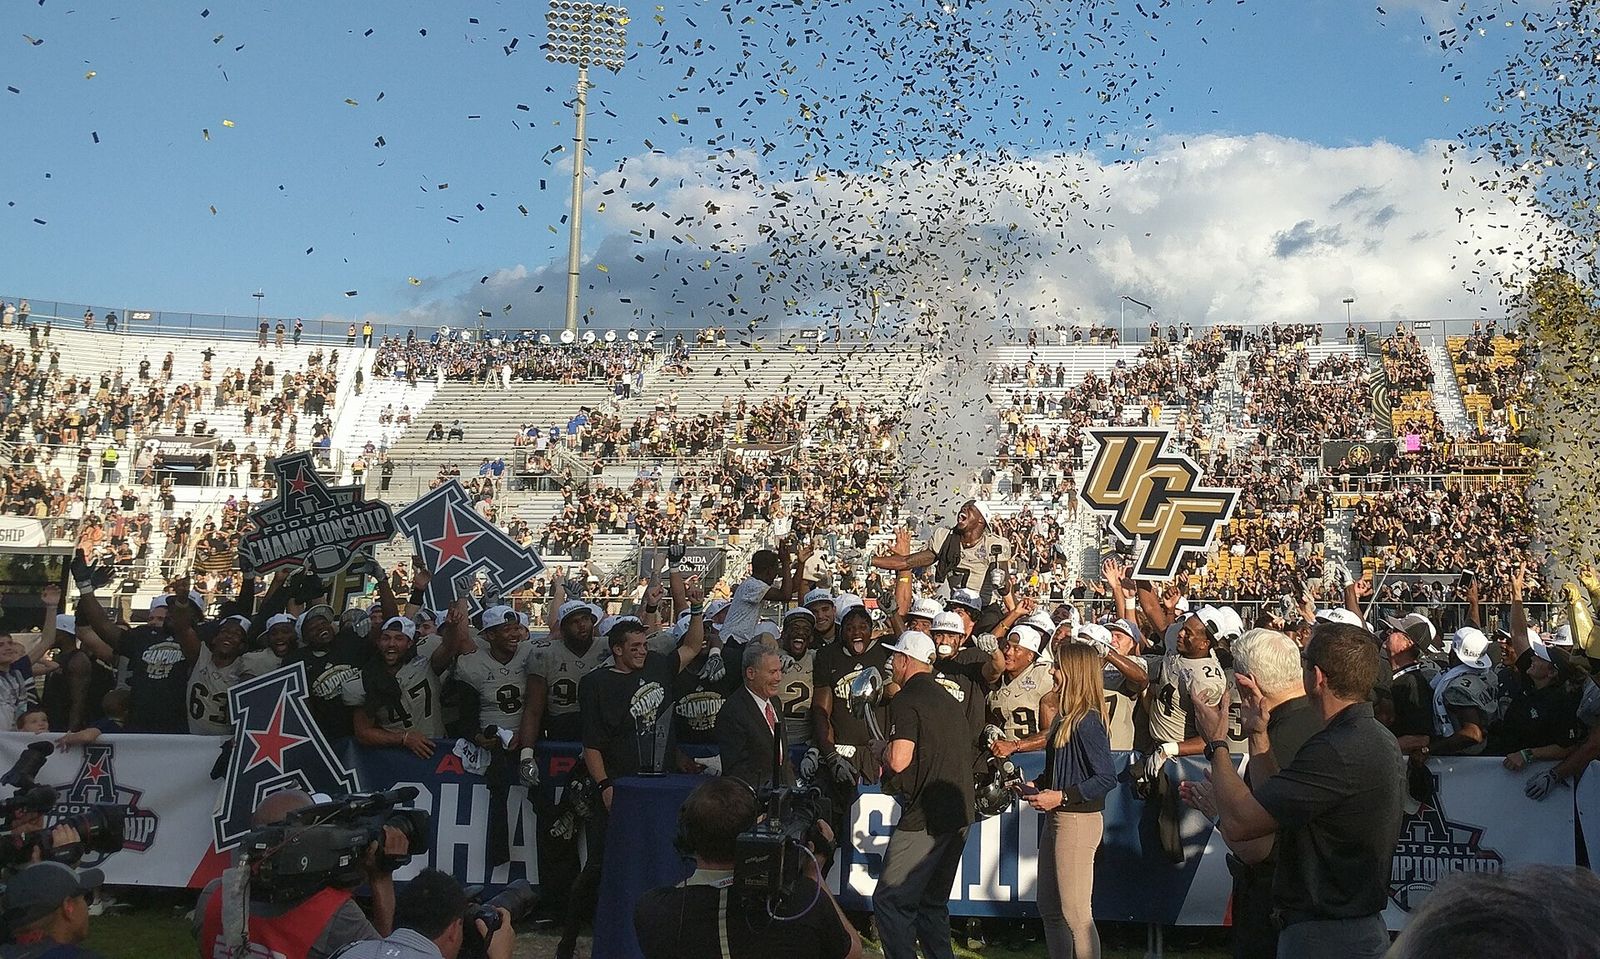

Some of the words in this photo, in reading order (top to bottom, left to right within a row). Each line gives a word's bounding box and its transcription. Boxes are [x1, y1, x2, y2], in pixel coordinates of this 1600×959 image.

[1080, 429, 1236, 577] UCF
[263, 504, 363, 535] FOOTBALL
[247, 507, 388, 568] CHAMPIONSHIP
[1201, 664, 1224, 681] 24
[386, 677, 432, 730] 47
[496, 683, 523, 714] 8
[300, 856, 309, 872] 9
